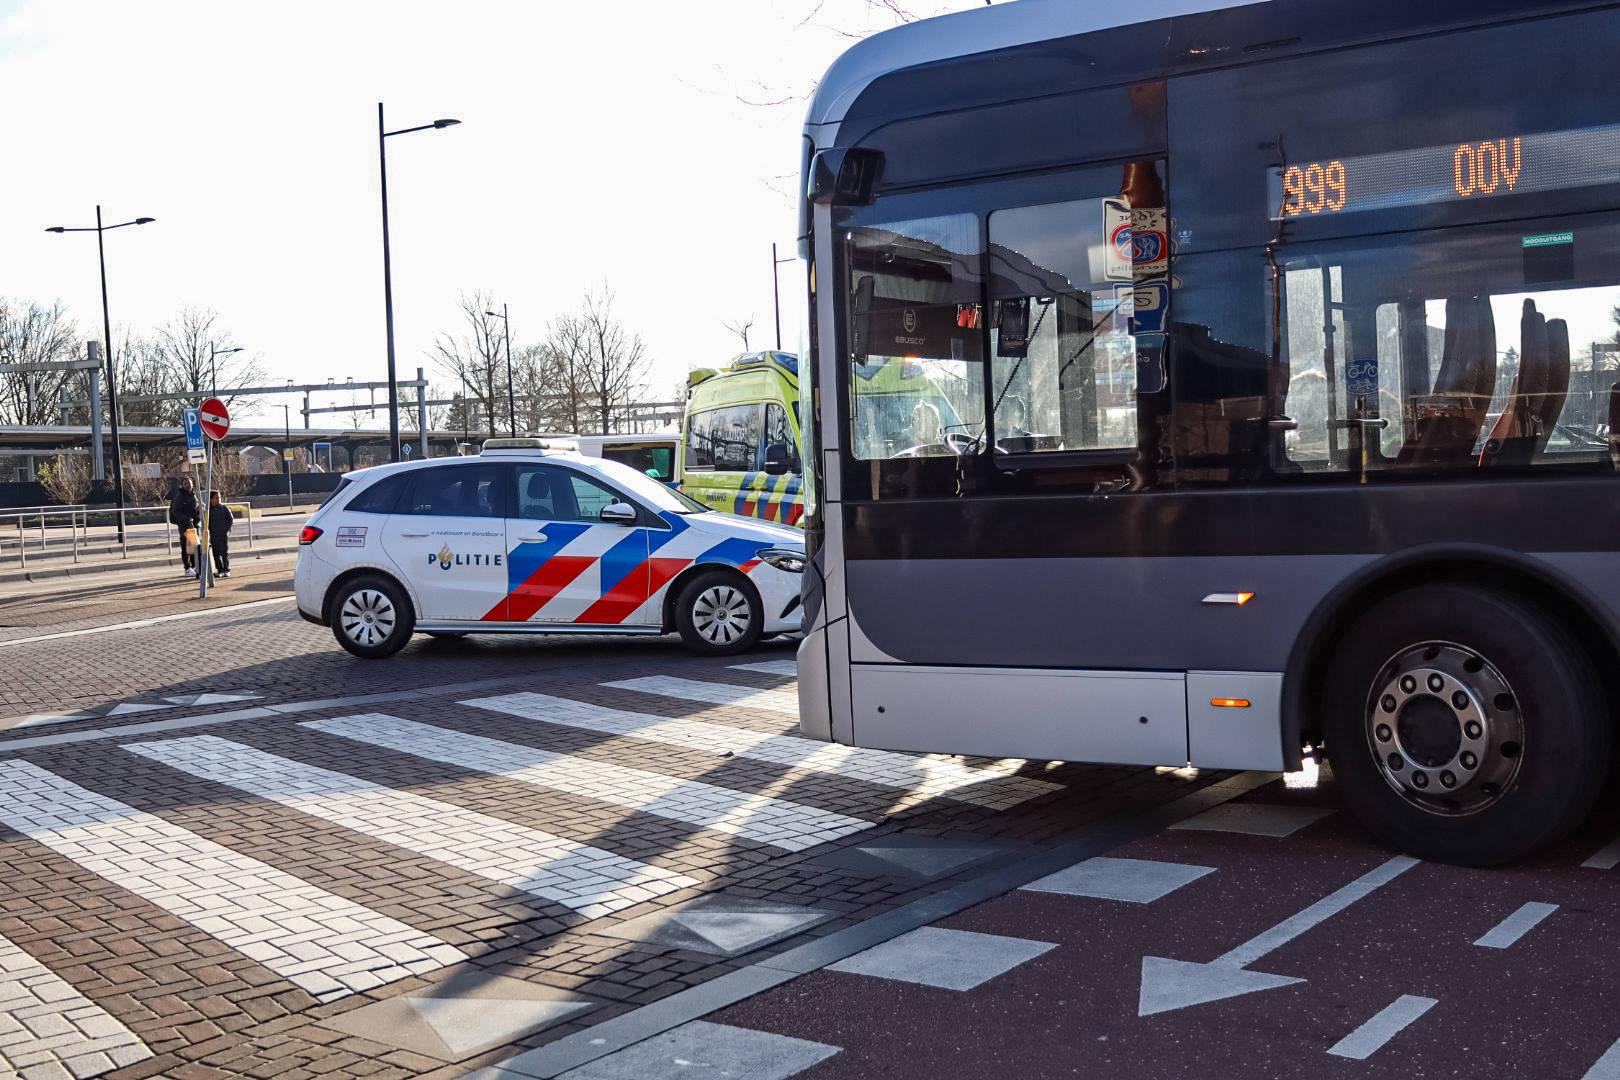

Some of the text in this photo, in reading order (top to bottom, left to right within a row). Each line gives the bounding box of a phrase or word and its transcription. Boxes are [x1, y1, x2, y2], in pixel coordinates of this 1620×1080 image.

[1284, 160, 1346, 216] 999
[1524, 234, 1572, 244] NOODUITGANG
[187, 411, 197, 433] P
[428, 553, 502, 571] POLITIE
